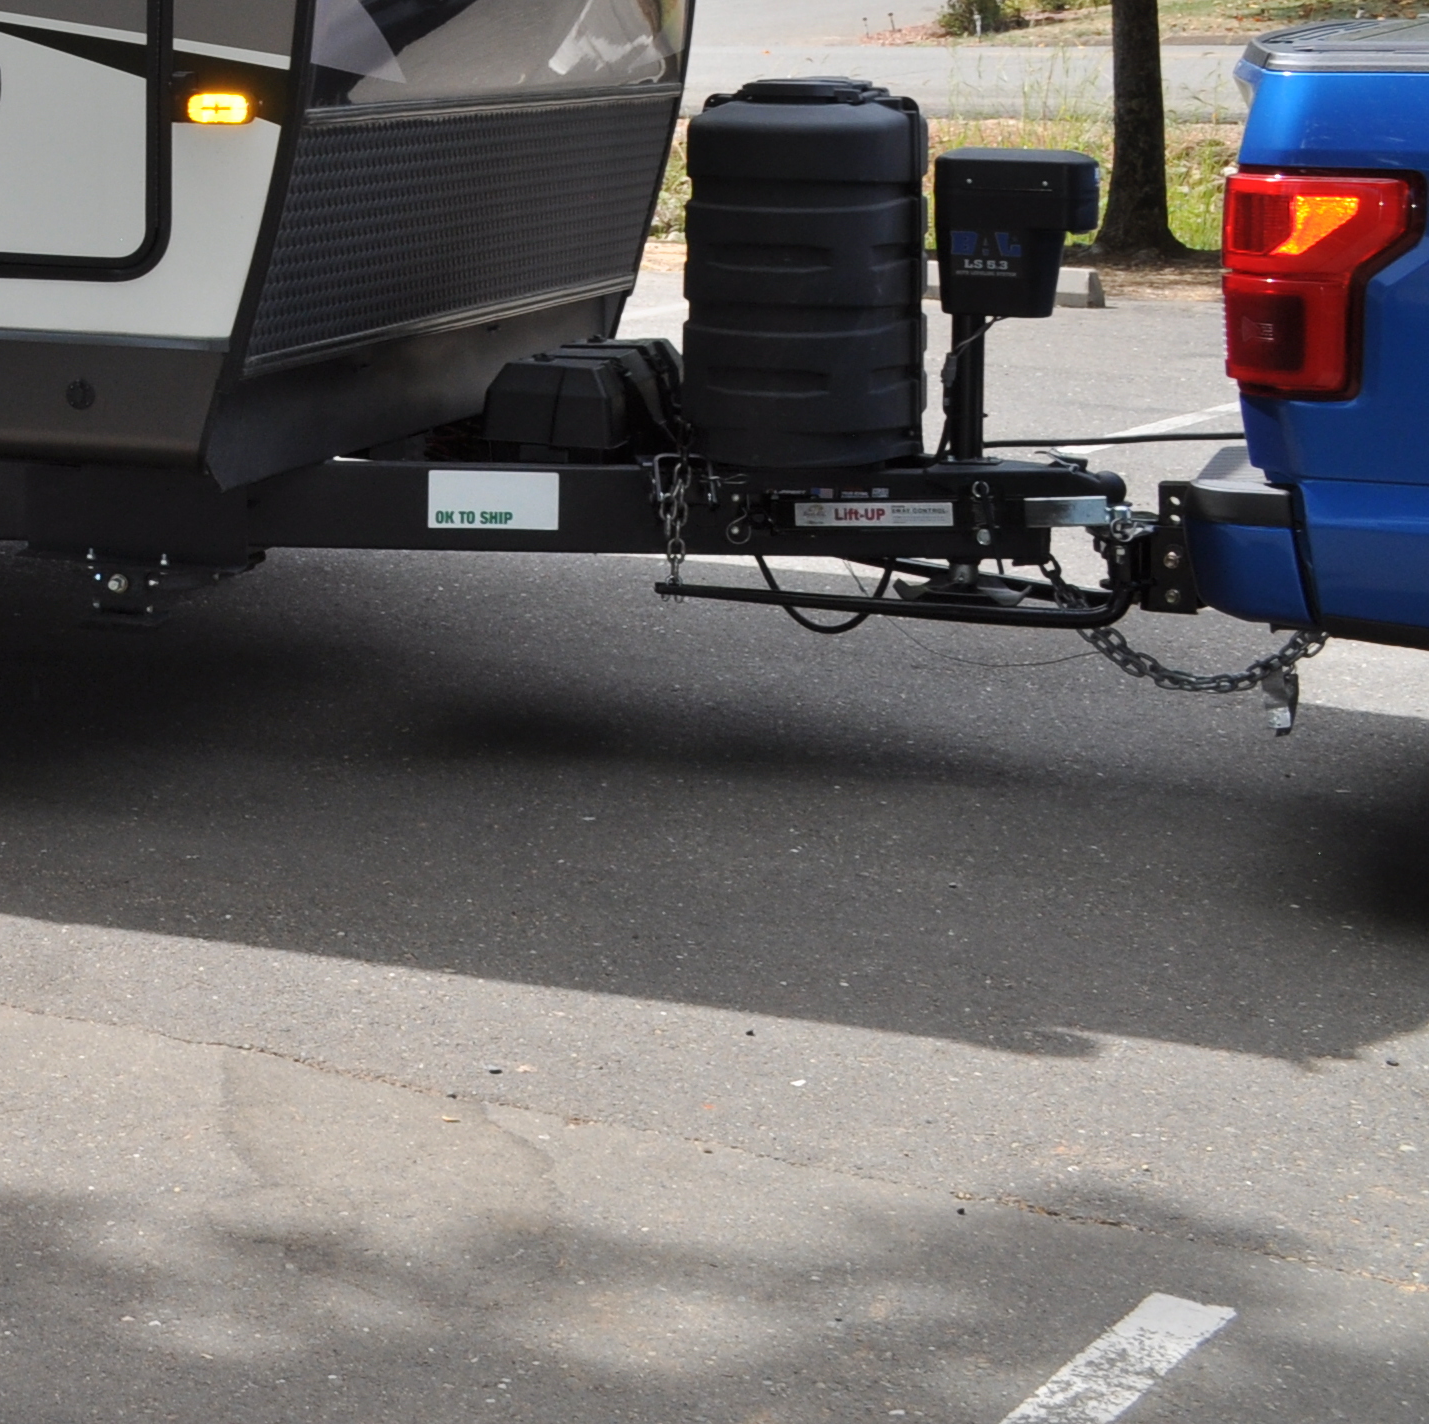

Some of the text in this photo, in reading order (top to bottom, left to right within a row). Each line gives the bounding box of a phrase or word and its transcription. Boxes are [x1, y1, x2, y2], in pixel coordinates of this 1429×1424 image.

[963, 258, 1008, 270] LS 5.3
[435, 510, 513, 525] OK TO SHIP
[834, 508, 886, 521] Lift-UP
